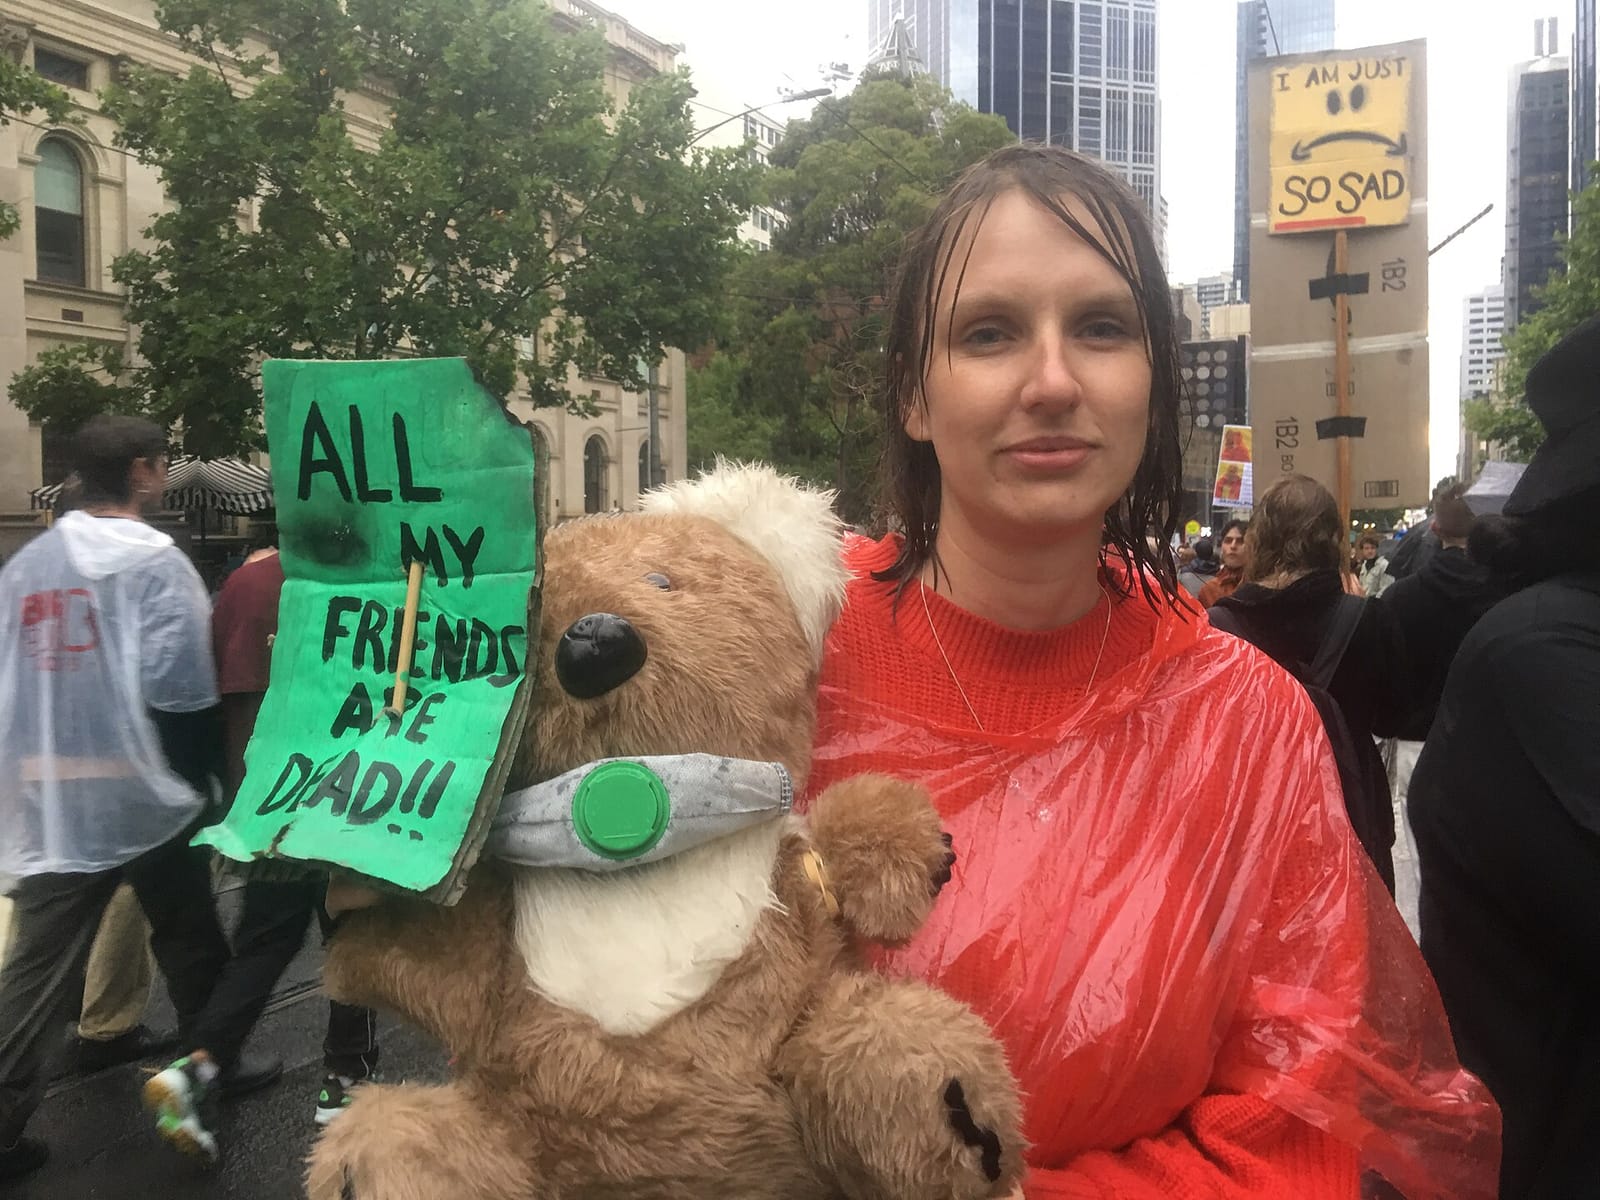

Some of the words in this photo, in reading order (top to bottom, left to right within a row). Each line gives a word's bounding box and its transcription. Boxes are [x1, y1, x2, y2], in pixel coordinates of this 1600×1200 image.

[1277, 73, 1290, 91] I
[1305, 65, 1340, 88] AM
[1348, 57, 1406, 80] JUST
[1278, 175, 1331, 216] SO
[1335, 169, 1405, 214] SAD
[1381, 257, 1407, 293] 1B2
[298, 401, 445, 503] ALL
[1275, 416, 1299, 449] 1B2
[400, 521, 485, 588] MY
[321, 595, 525, 688] FRIENDS
